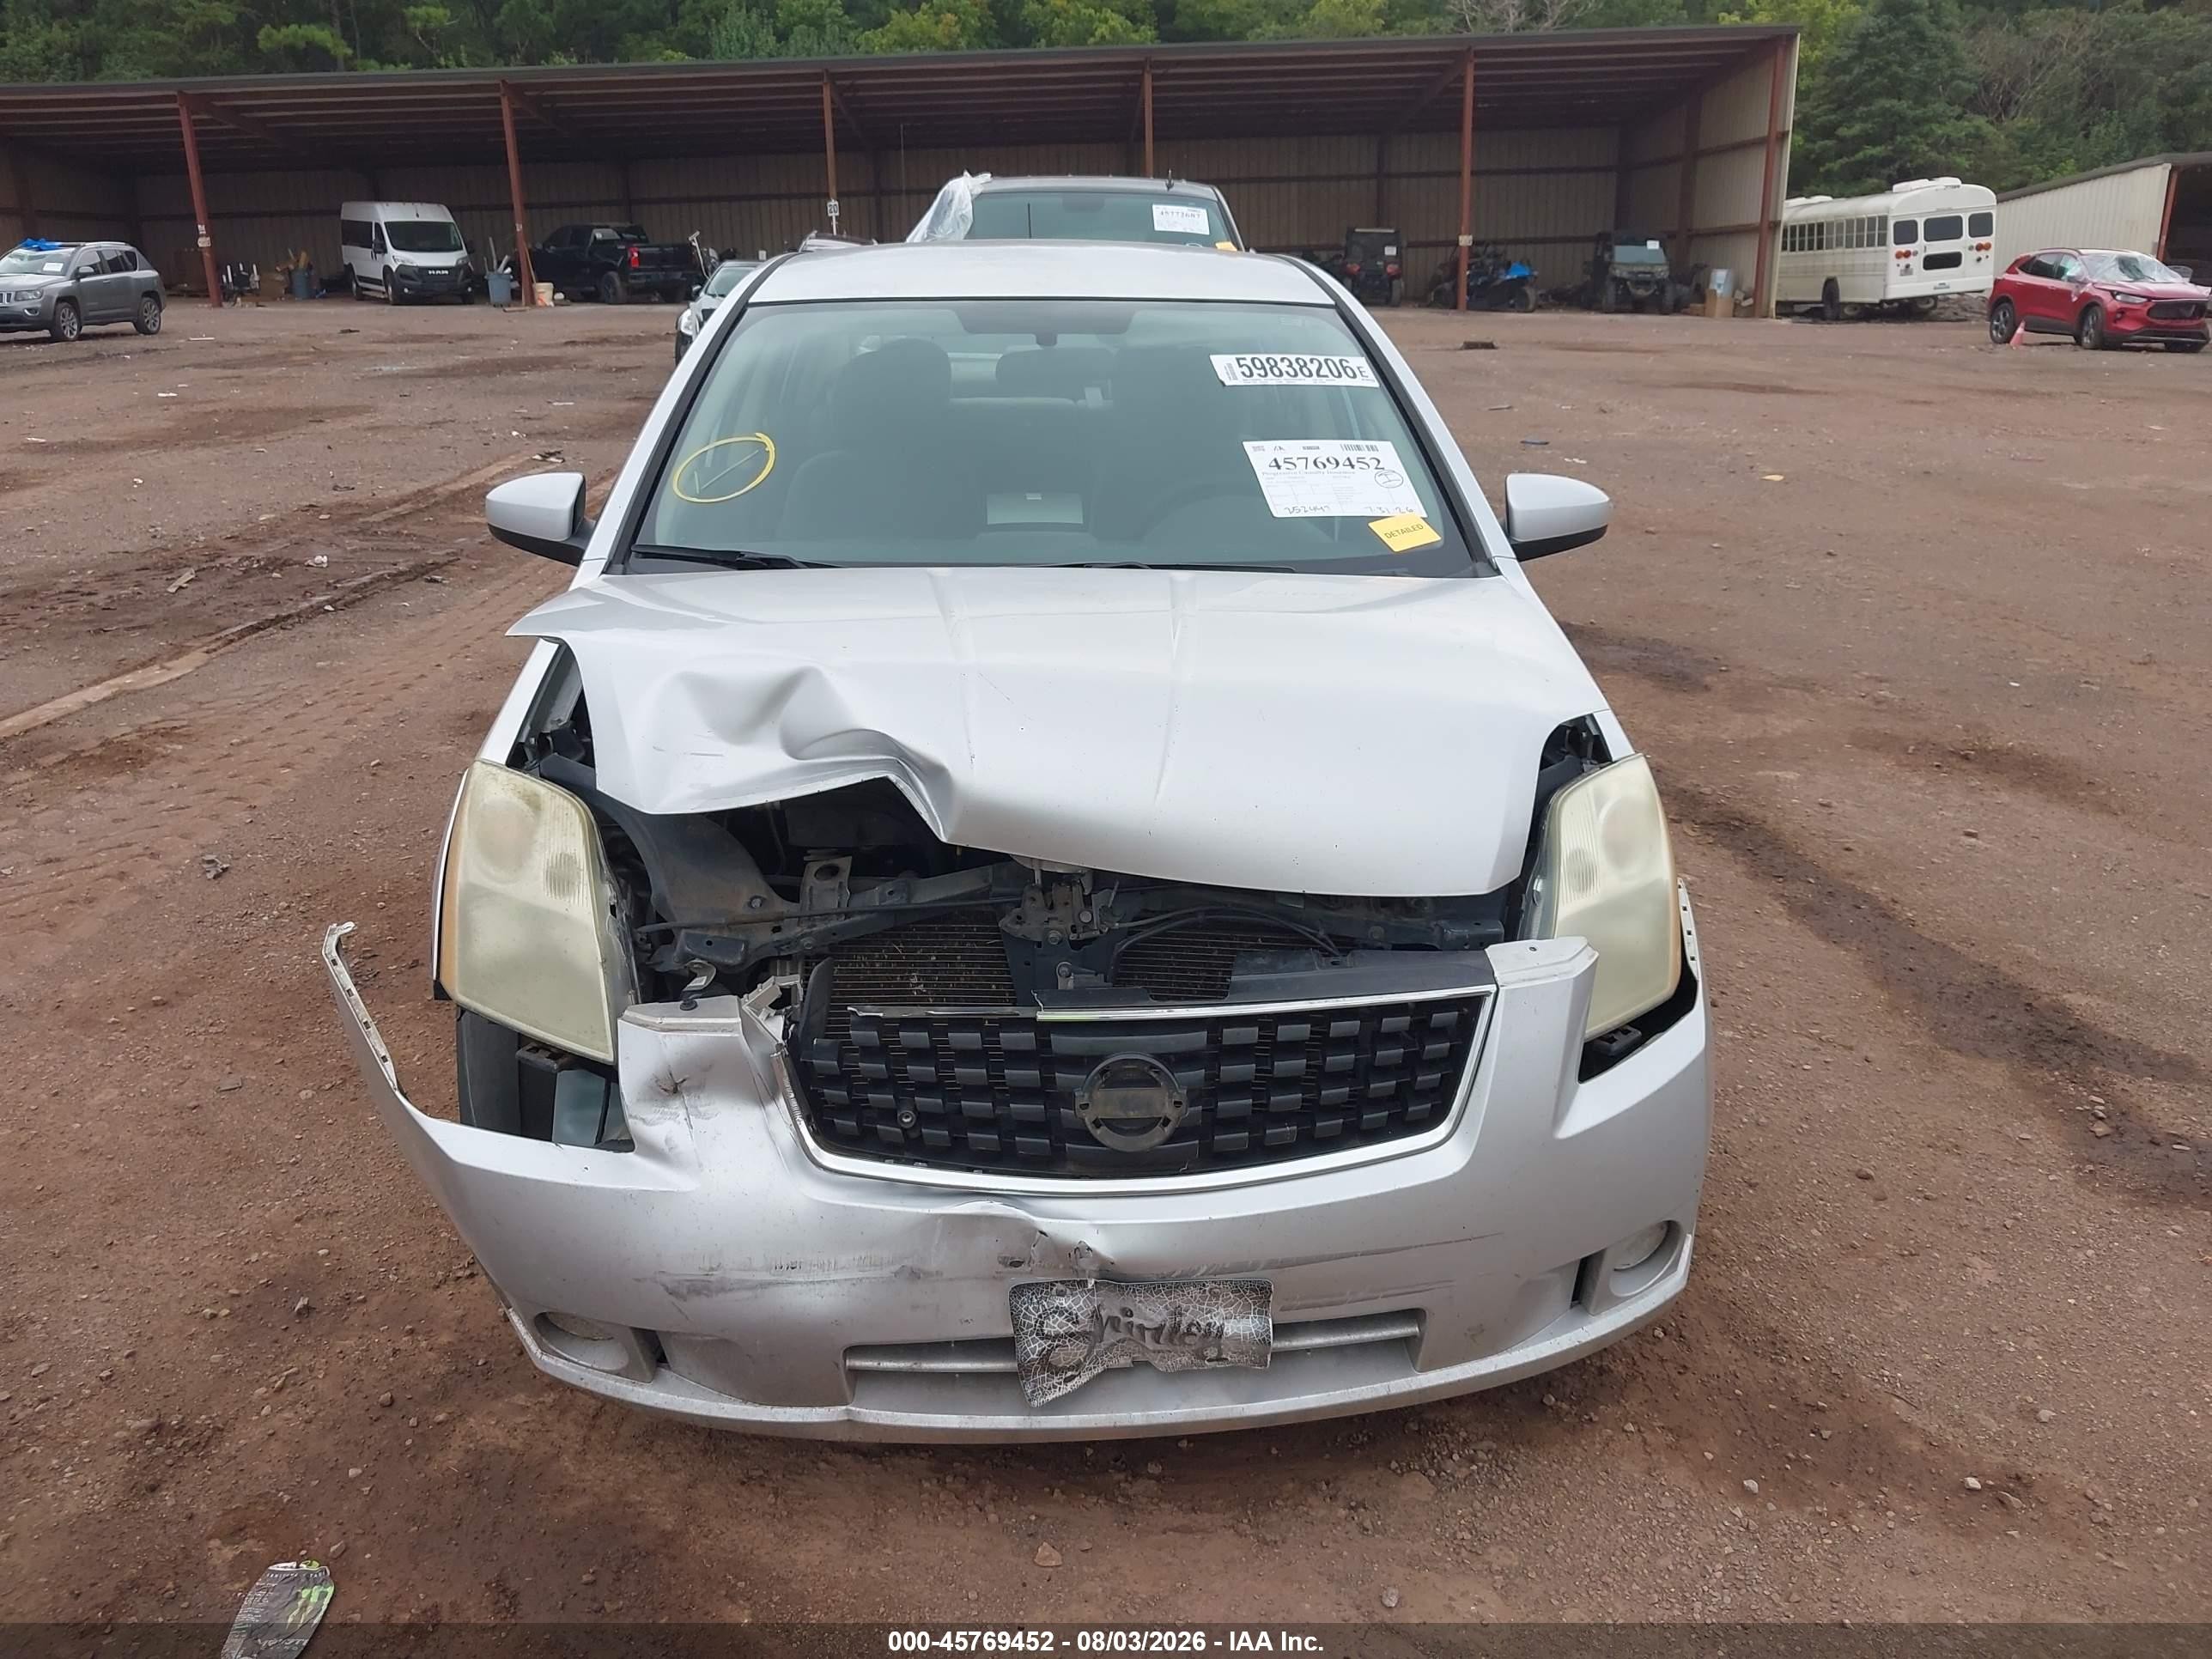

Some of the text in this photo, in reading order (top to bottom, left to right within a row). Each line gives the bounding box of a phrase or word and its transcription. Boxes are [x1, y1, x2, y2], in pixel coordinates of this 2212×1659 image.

[828, 204, 838, 214] 20
[1236, 356, 1358, 380] 59838206
[1358, 366, 1369, 378] E
[1268, 456, 1385, 471] 45769452
[1384, 523, 1424, 539] DETAILED
